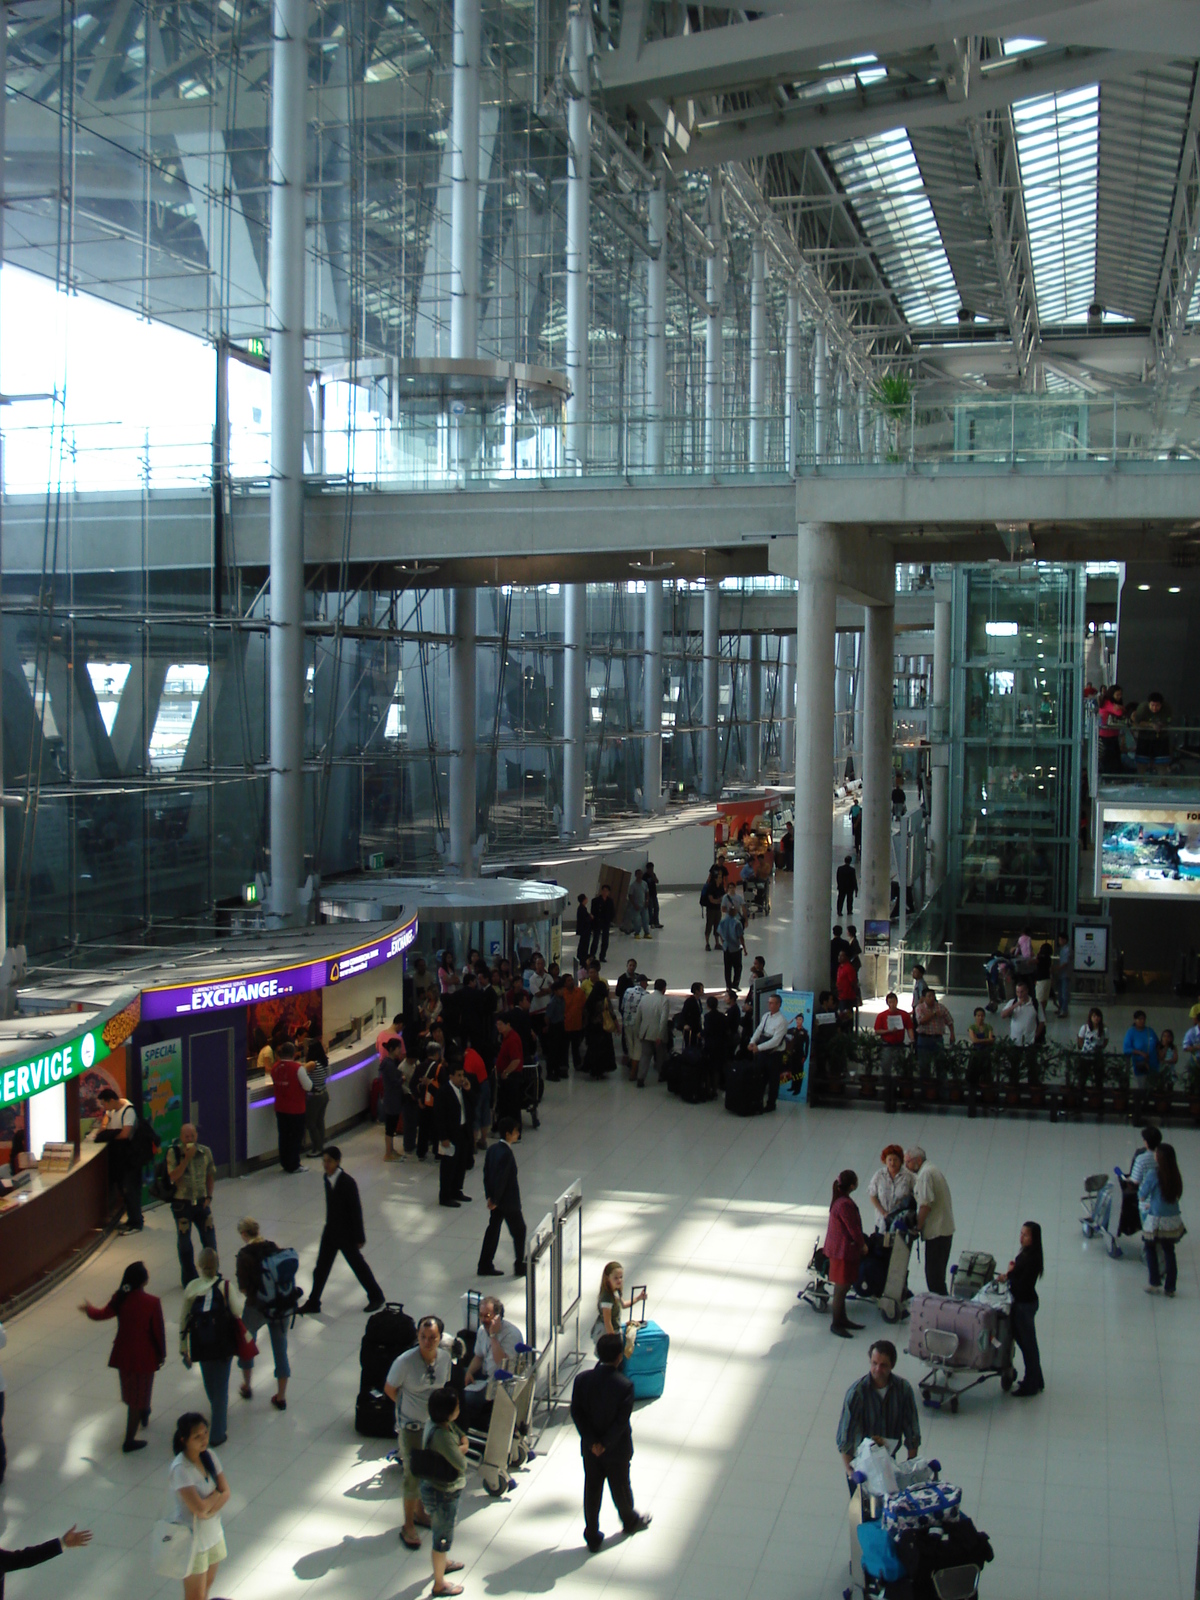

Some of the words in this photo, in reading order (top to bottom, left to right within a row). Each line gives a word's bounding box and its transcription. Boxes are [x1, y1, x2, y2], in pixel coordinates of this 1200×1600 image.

[493, 943, 501, 955] 2
[191, 979, 279, 1011] EXCHANGE
[144, 1043, 177, 1062] SPECIAL
[0, 1045, 73, 1102] ERVICE
